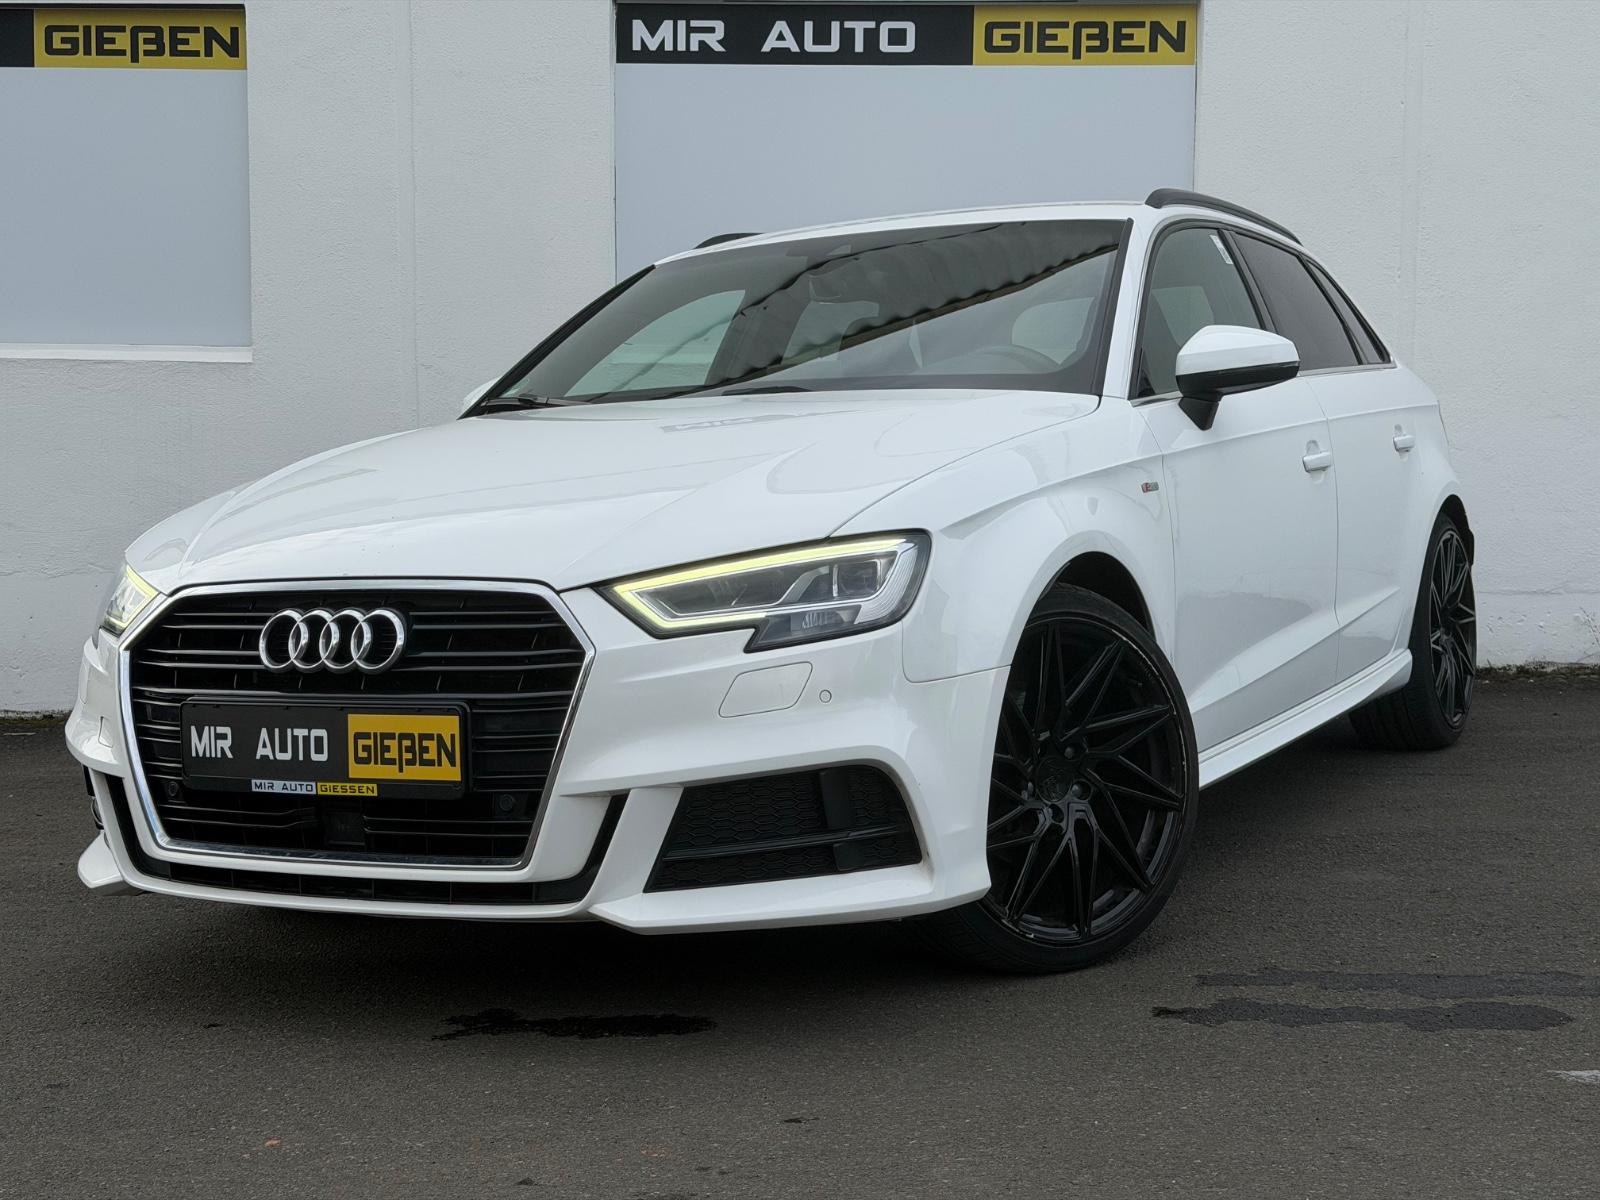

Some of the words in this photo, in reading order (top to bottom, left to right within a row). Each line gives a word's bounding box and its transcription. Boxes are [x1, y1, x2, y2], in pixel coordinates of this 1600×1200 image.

[631, 18, 727, 53] MIR
[760, 20, 917, 53] AUTO
[190, 725, 234, 759] MIR
[255, 727, 329, 762] AUTO
[254, 781, 275, 791] MIR
[281, 782, 314, 793] AUTO
[320, 784, 375, 794] GIESSEN
